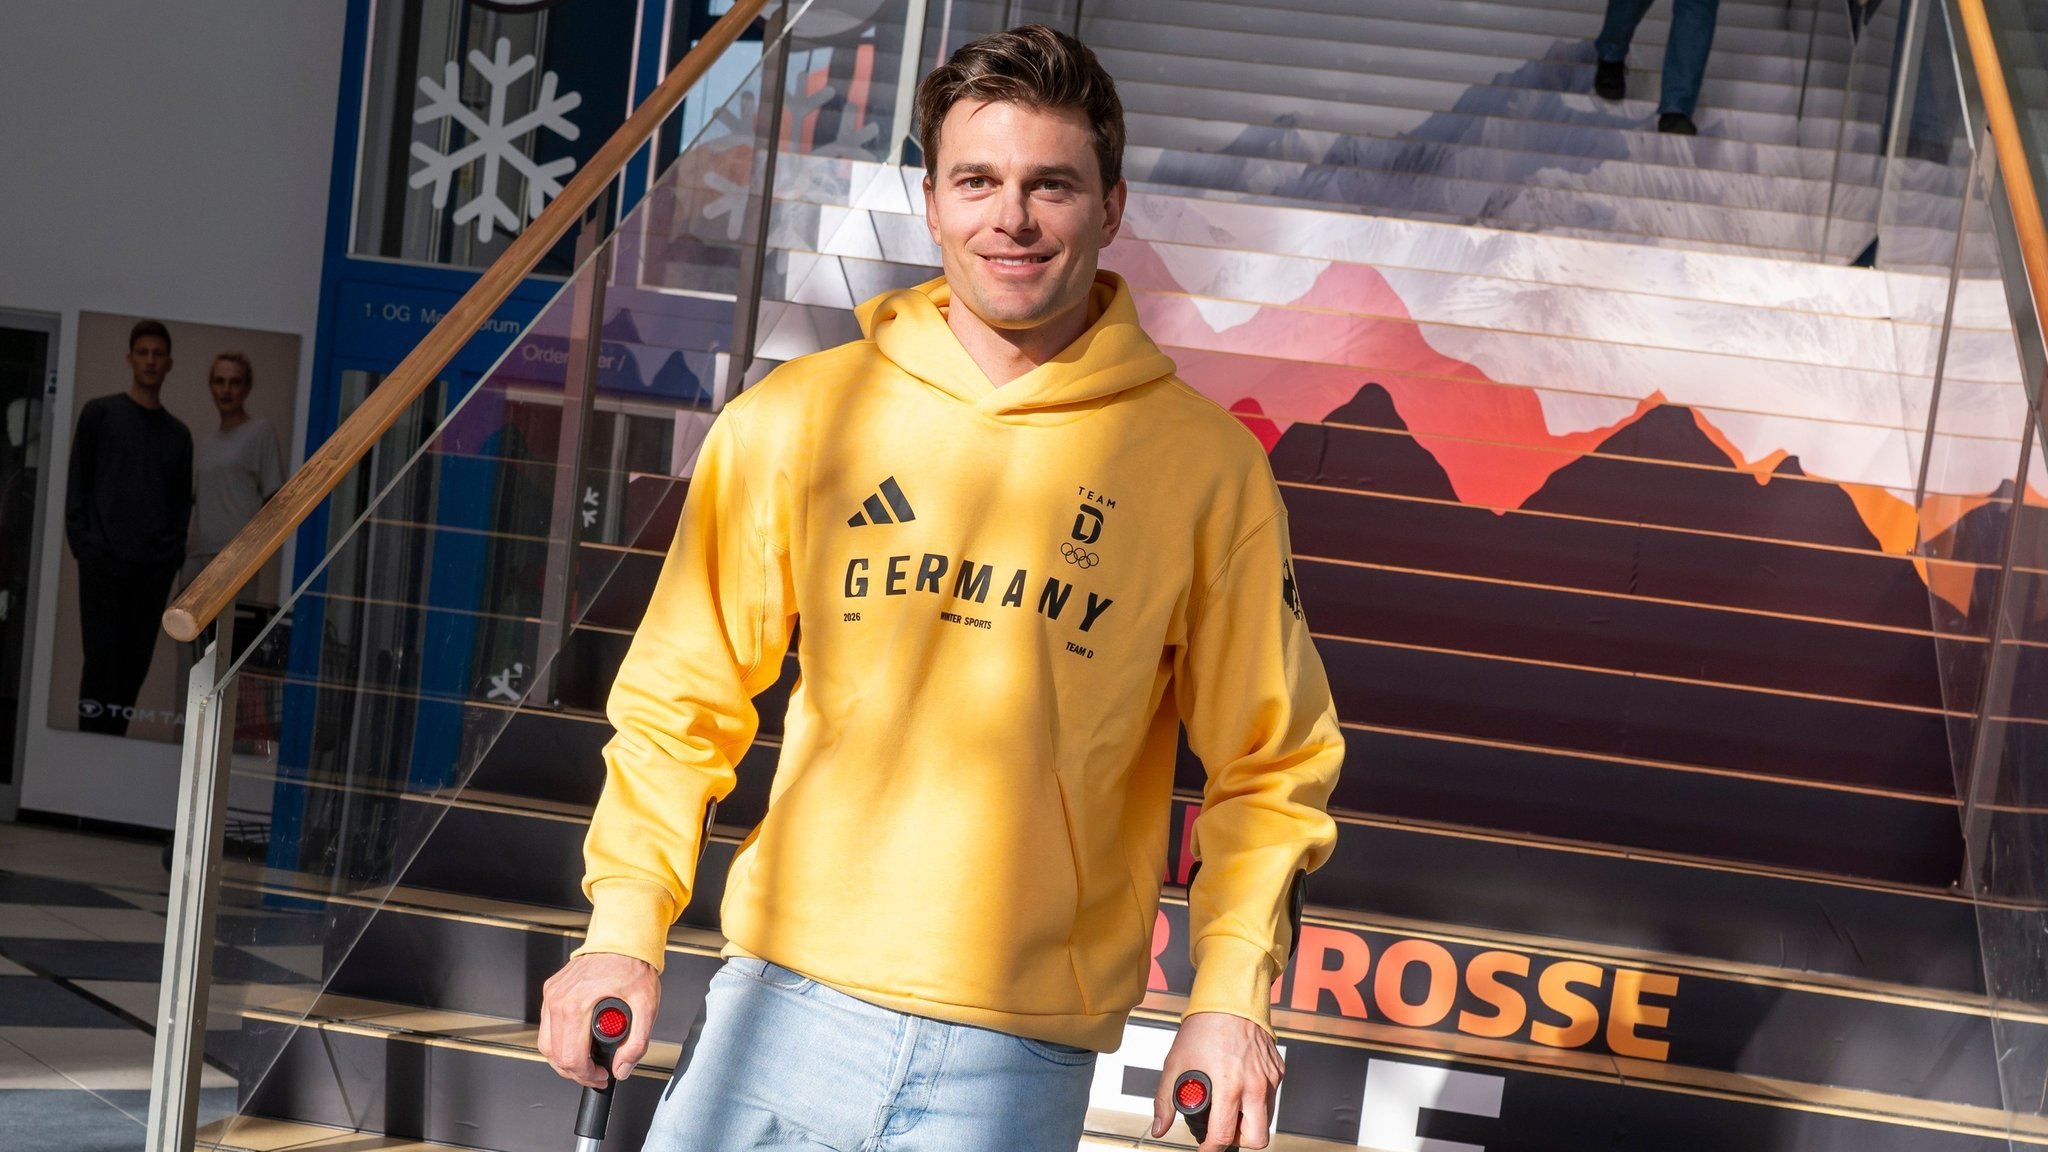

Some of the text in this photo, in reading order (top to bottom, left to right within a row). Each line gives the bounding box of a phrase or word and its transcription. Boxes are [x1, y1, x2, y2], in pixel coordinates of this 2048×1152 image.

[382, 303, 411, 322] OG
[1078, 486, 1116, 509] TEAM
[844, 553, 1113, 633] GERMANY
[843, 612, 861, 622] 2026
[940, 611, 992, 630] WINTER SPORTS
[1066, 641, 1094, 659] TEAM D
[106, 703, 156, 723] TOM
[1271, 924, 1680, 1062] ROSSE
